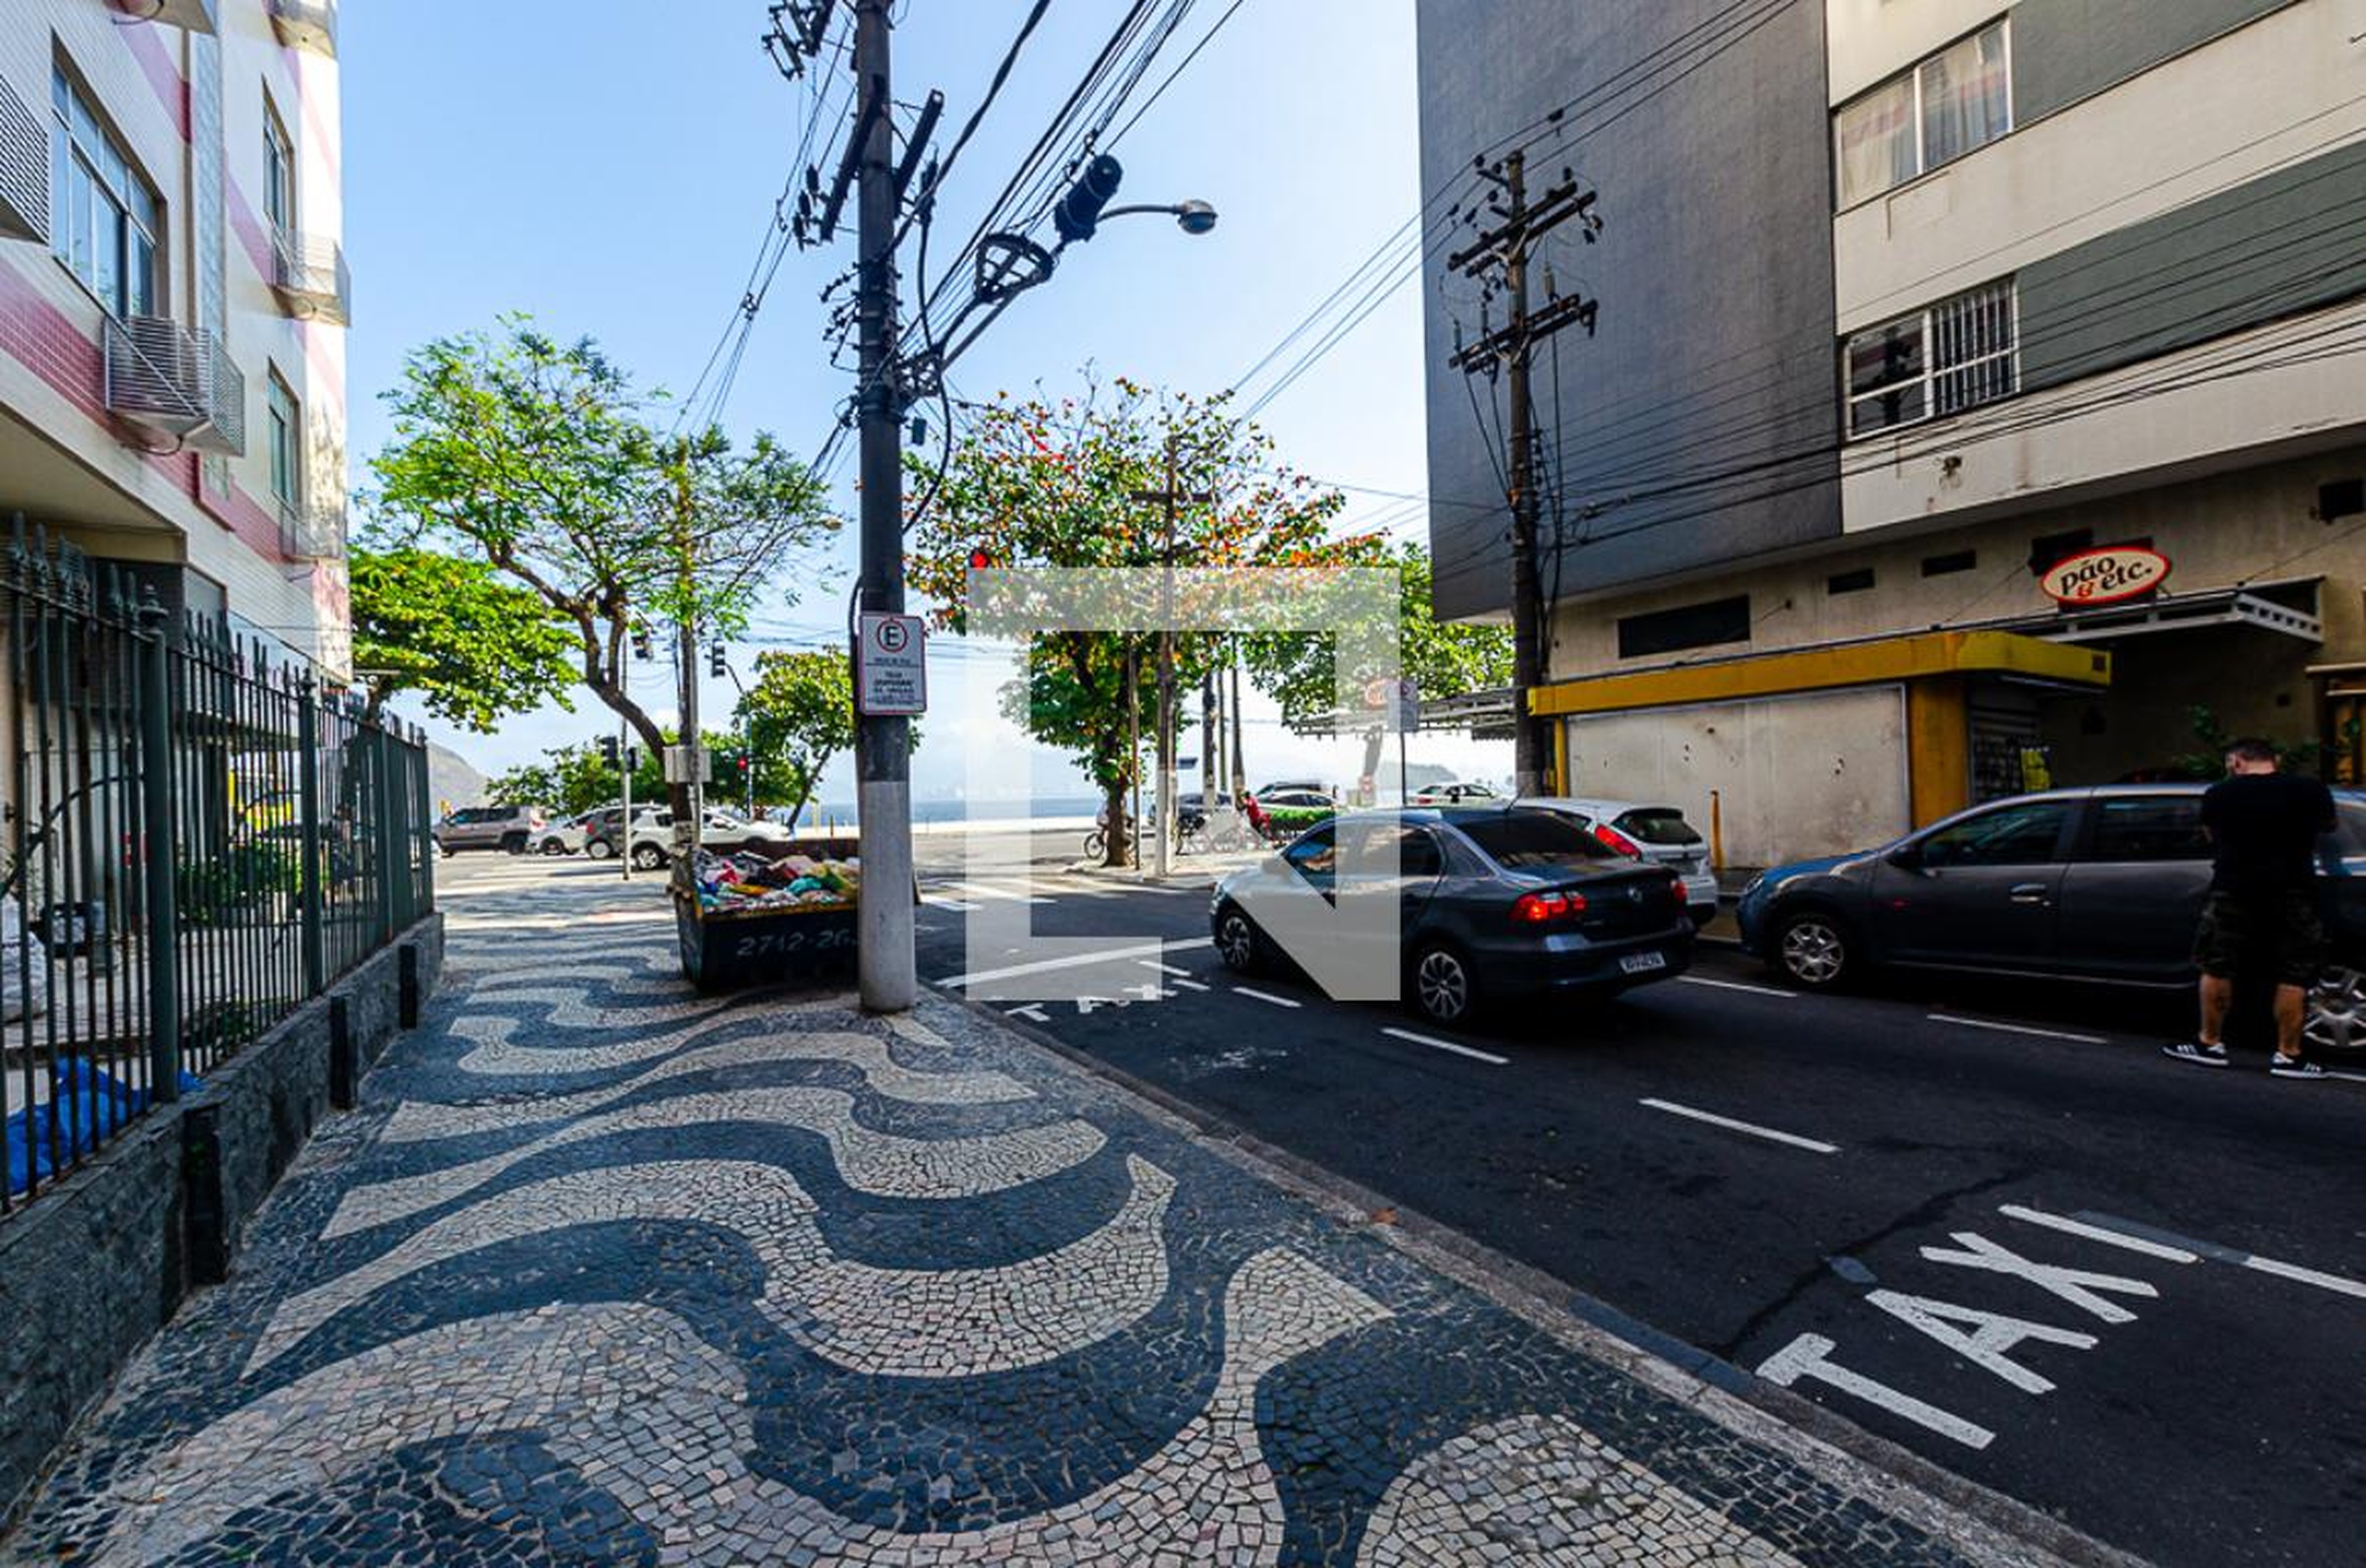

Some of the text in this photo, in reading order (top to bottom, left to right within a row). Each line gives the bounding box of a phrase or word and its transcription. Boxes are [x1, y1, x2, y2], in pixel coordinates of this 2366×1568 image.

[2060, 557, 2115, 595] pão
[2102, 561, 2152, 590] etc.
[884, 626, 900, 646] E
[1755, 1204, 2200, 1450] TAXI
